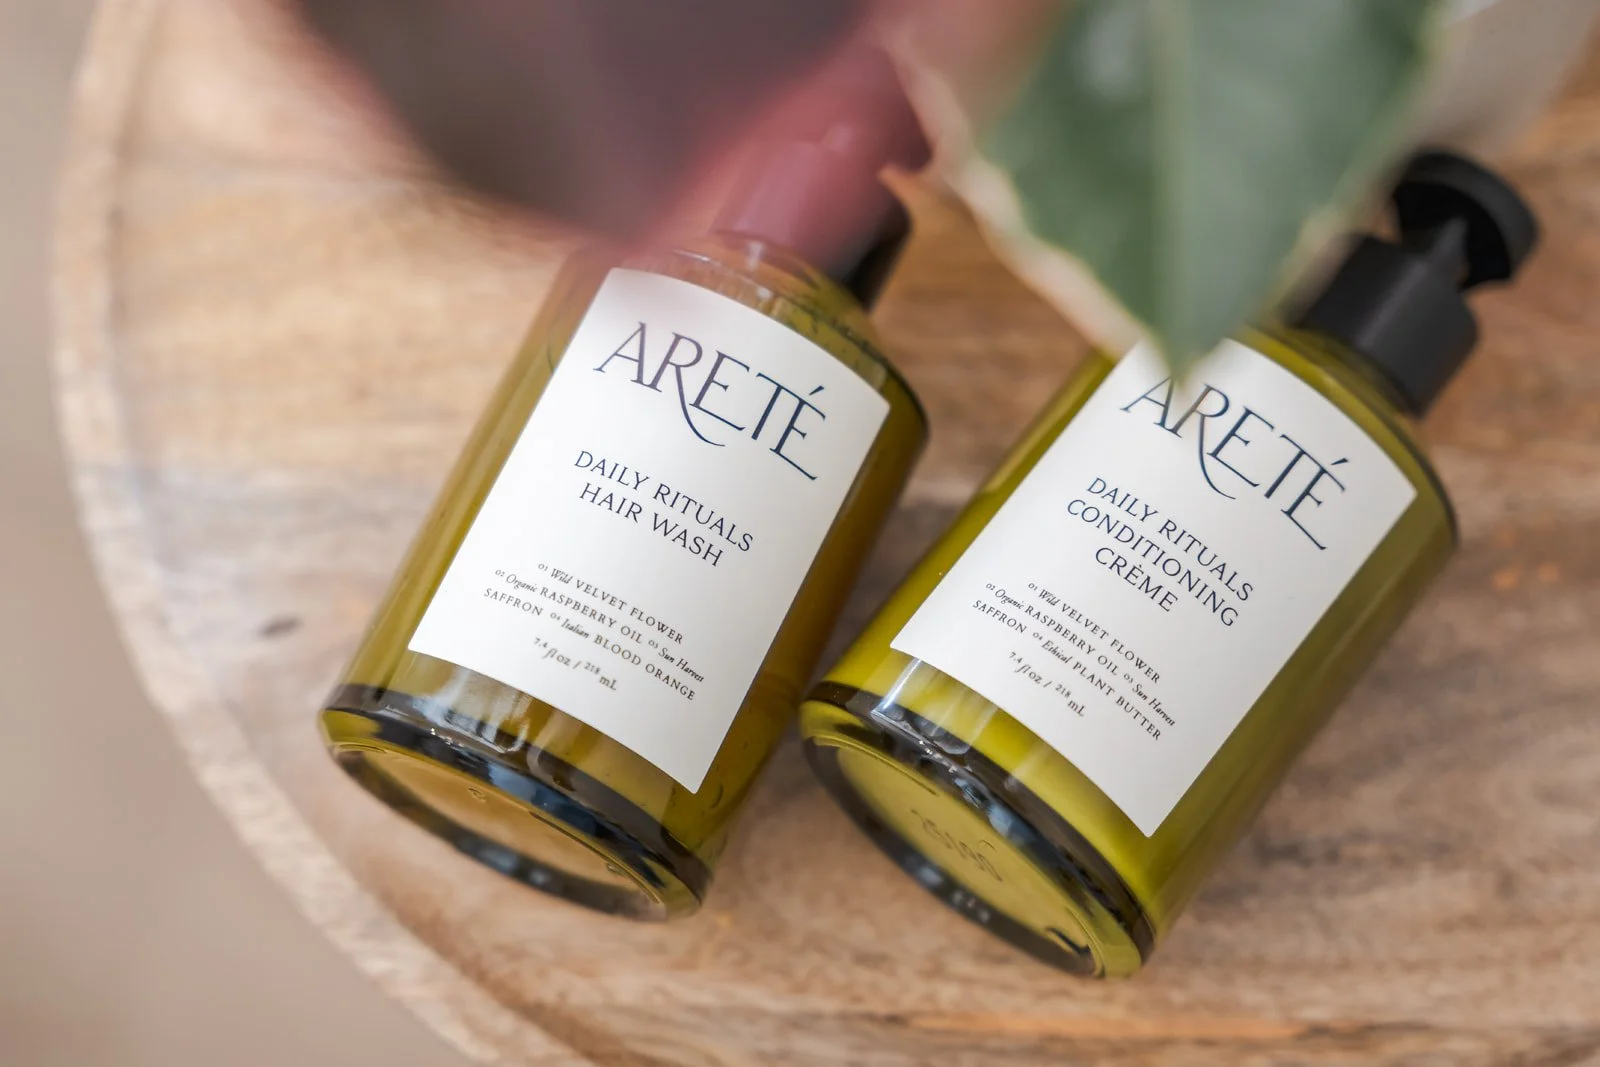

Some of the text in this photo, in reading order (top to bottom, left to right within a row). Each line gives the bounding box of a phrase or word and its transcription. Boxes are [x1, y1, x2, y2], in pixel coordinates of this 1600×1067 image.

[593, 321, 827, 481] ARETÉ
[574, 450, 754, 552] DAILY RITUALS
[1119, 374, 1350, 551] ARETÉ
[579, 482, 724, 567] HAIR WASH
[1067, 499, 1239, 627] CONDITIONING
[1086, 477, 1254, 602] DAILY RITUALS
[1095, 547, 1179, 612] CRÈME
[483, 588, 544, 617] SAFFRON
[561, 618, 591, 639] Italian
[594, 634, 642, 666] BLOOD
[645, 663, 696, 701] ORANGE
[505, 573, 539, 593] Organic
[539, 587, 617, 628] RASPBERRY
[620, 625, 643, 644] OIL
[659, 647, 675, 663] Sun
[676, 657, 704, 683] Harvest
[550, 568, 574, 585] Wild
[575, 579, 628, 611] VELVET
[630, 607, 684, 645] FLOWER
[994, 588, 1025, 610] Organic
[1025, 605, 1096, 655] RASPBERRY
[1097, 655, 1119, 676] OIL
[1132, 683, 1148, 701] Sun
[1148, 698, 1176, 726] Harvest
[1038, 589, 1061, 606] Wild
[1061, 605, 1109, 639] VELVET
[1110, 639, 1161, 684] FLOWER
[599, 674, 618, 691] mL
[972, 599, 1027, 633] SAFFRON
[1041, 639, 1074, 664] Ethical
[1073, 661, 1115, 697] PLANT
[1115, 696, 1162, 741] BUTTER
[1068, 700, 1085, 717] mL
